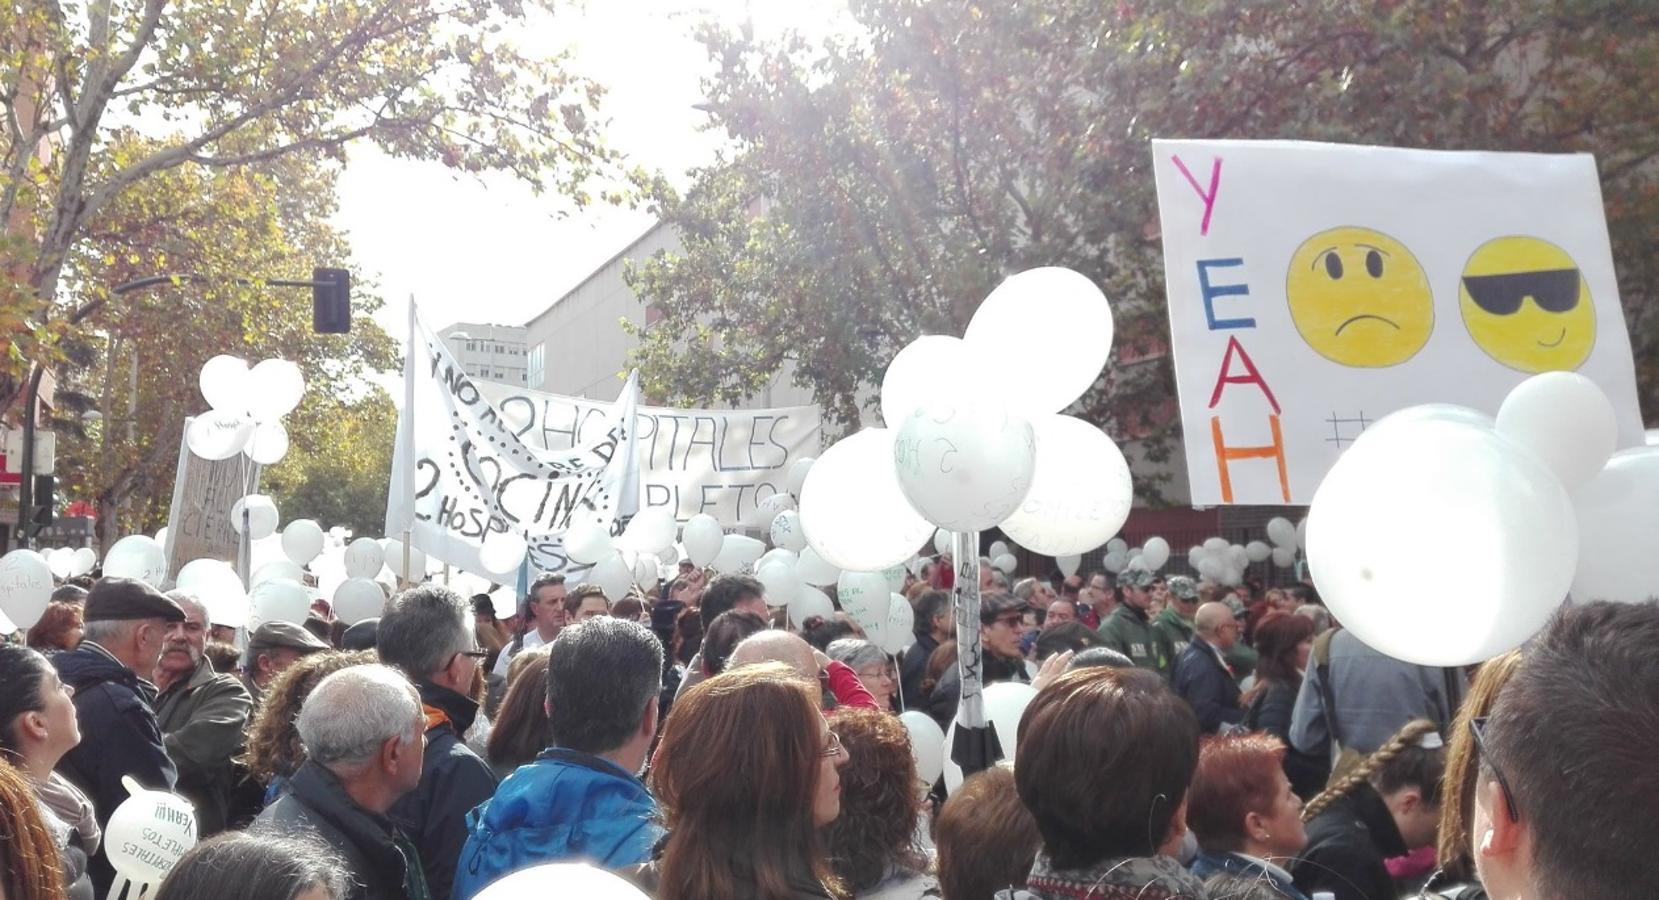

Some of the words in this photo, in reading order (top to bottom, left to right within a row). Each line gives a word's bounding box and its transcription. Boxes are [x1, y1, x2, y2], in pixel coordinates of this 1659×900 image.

[1172, 155, 1291, 503] YEAH
[544, 400, 788, 471] HOPITALES
[645, 482, 780, 523] PLETO
[0, 573, 42, 598] spitales
